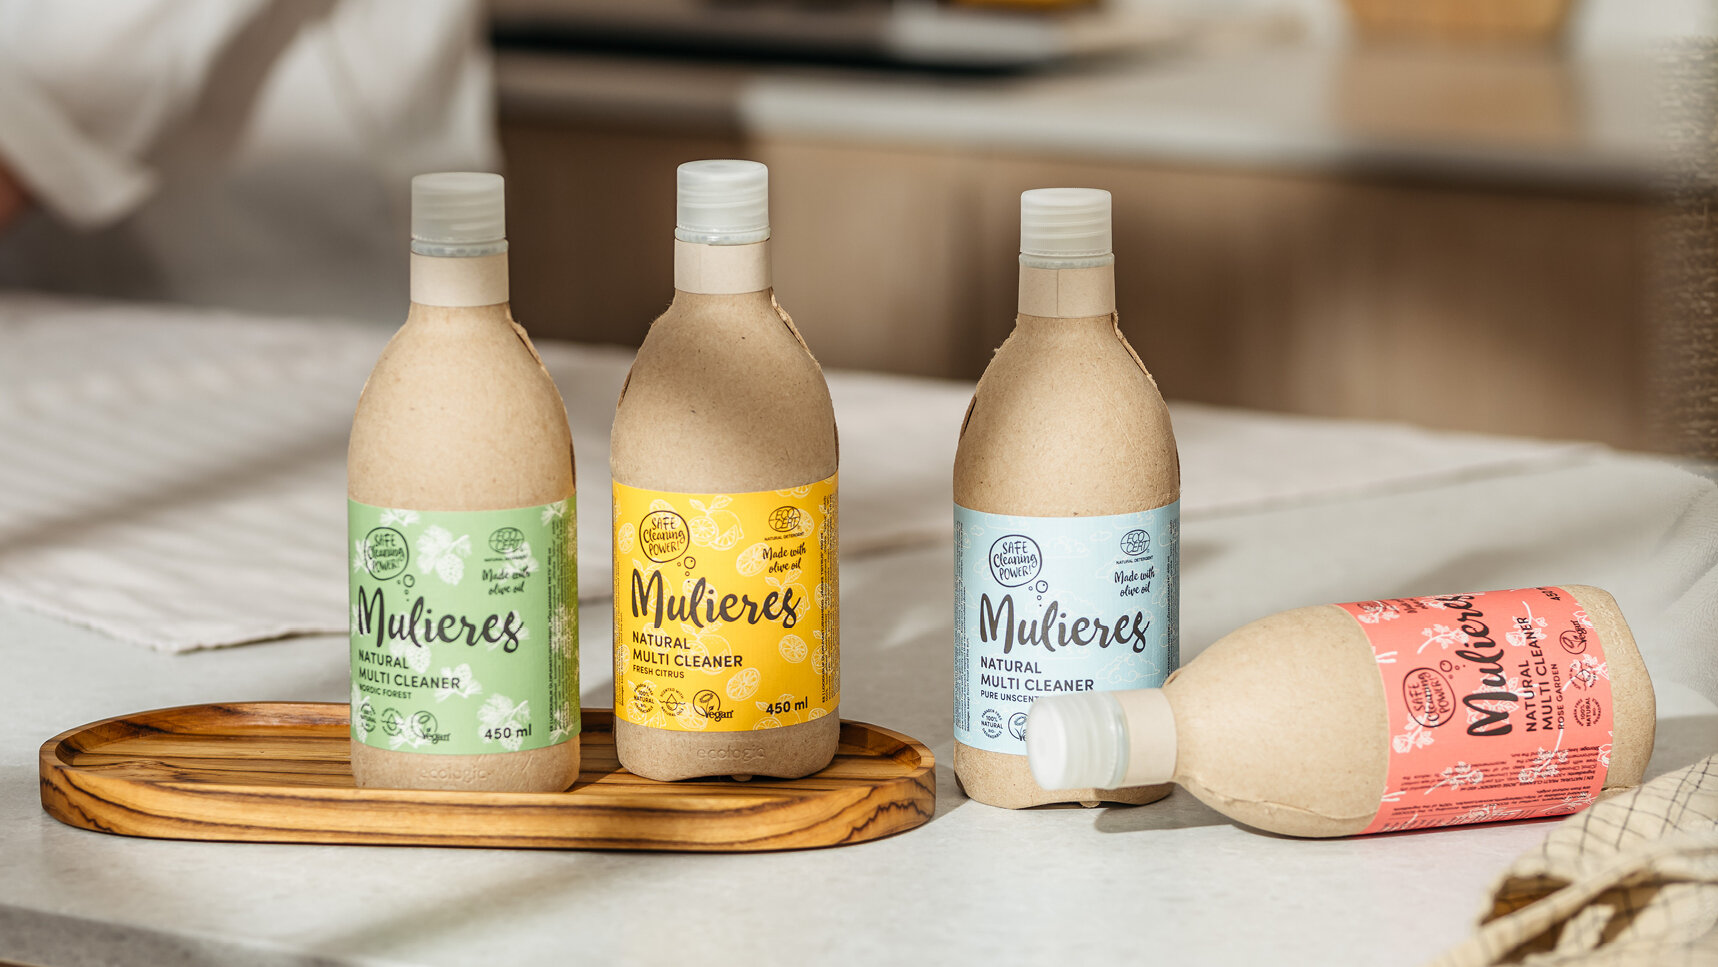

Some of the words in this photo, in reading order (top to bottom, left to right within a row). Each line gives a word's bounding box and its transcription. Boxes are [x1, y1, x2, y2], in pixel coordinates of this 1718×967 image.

[651, 516, 676, 531] SAFE
[643, 528, 686, 545] Cleaning
[648, 541, 681, 557] POWER!
[762, 547, 788, 561] Made
[789, 542, 807, 558] with
[1002, 540, 1029, 555] SAFE
[768, 561, 790, 574] olive
[791, 557, 802, 571] oil
[993, 553, 1038, 569] Cleaning
[482, 569, 510, 583] Made
[999, 565, 1032, 581] POWER!
[1114, 571, 1139, 585] Made
[1140, 565, 1156, 581] with
[488, 582, 512, 596] olive
[512, 581, 526, 594] oil
[1119, 585, 1140, 598] olive
[1140, 581, 1151, 595] oil
[631, 568, 802, 629] Mulieres
[358, 585, 526, 654] Mulieres
[979, 592, 1151, 654] Mulieres
[632, 630, 691, 650] NATURAL
[1517, 617, 1547, 676] CLEANER
[358, 649, 410, 670] NATURAL
[632, 648, 670, 666] MULTI
[674, 654, 743, 668] CLEANER
[980, 655, 1043, 674] NATURAL
[1435, 595, 1519, 737] Mulieres
[358, 666, 391, 685] MULTI
[394, 673, 461, 689] CLEANER
[632, 664, 654, 676] FRESH
[655, 668, 685, 679] CITRUS
[359, 683, 383, 697] NORDIC
[383, 687, 412, 700] FOREST
[980, 673, 1020, 690] MULTI
[1024, 679, 1095, 692] CLEANER
[1551, 663, 1563, 703] GARDEN
[980, 689, 999, 700] PURE
[1408, 682, 1426, 712] SAFE
[1518, 660, 1537, 732] NATURAL
[765, 701, 791, 715] 450
[794, 695, 808, 711] ml
[1539, 681, 1553, 730] MULTI
[704, 707, 734, 723] Vegan
[484, 727, 512, 740] 450
[516, 723, 532, 738] ml
[980, 720, 1004, 730] NATURAL
